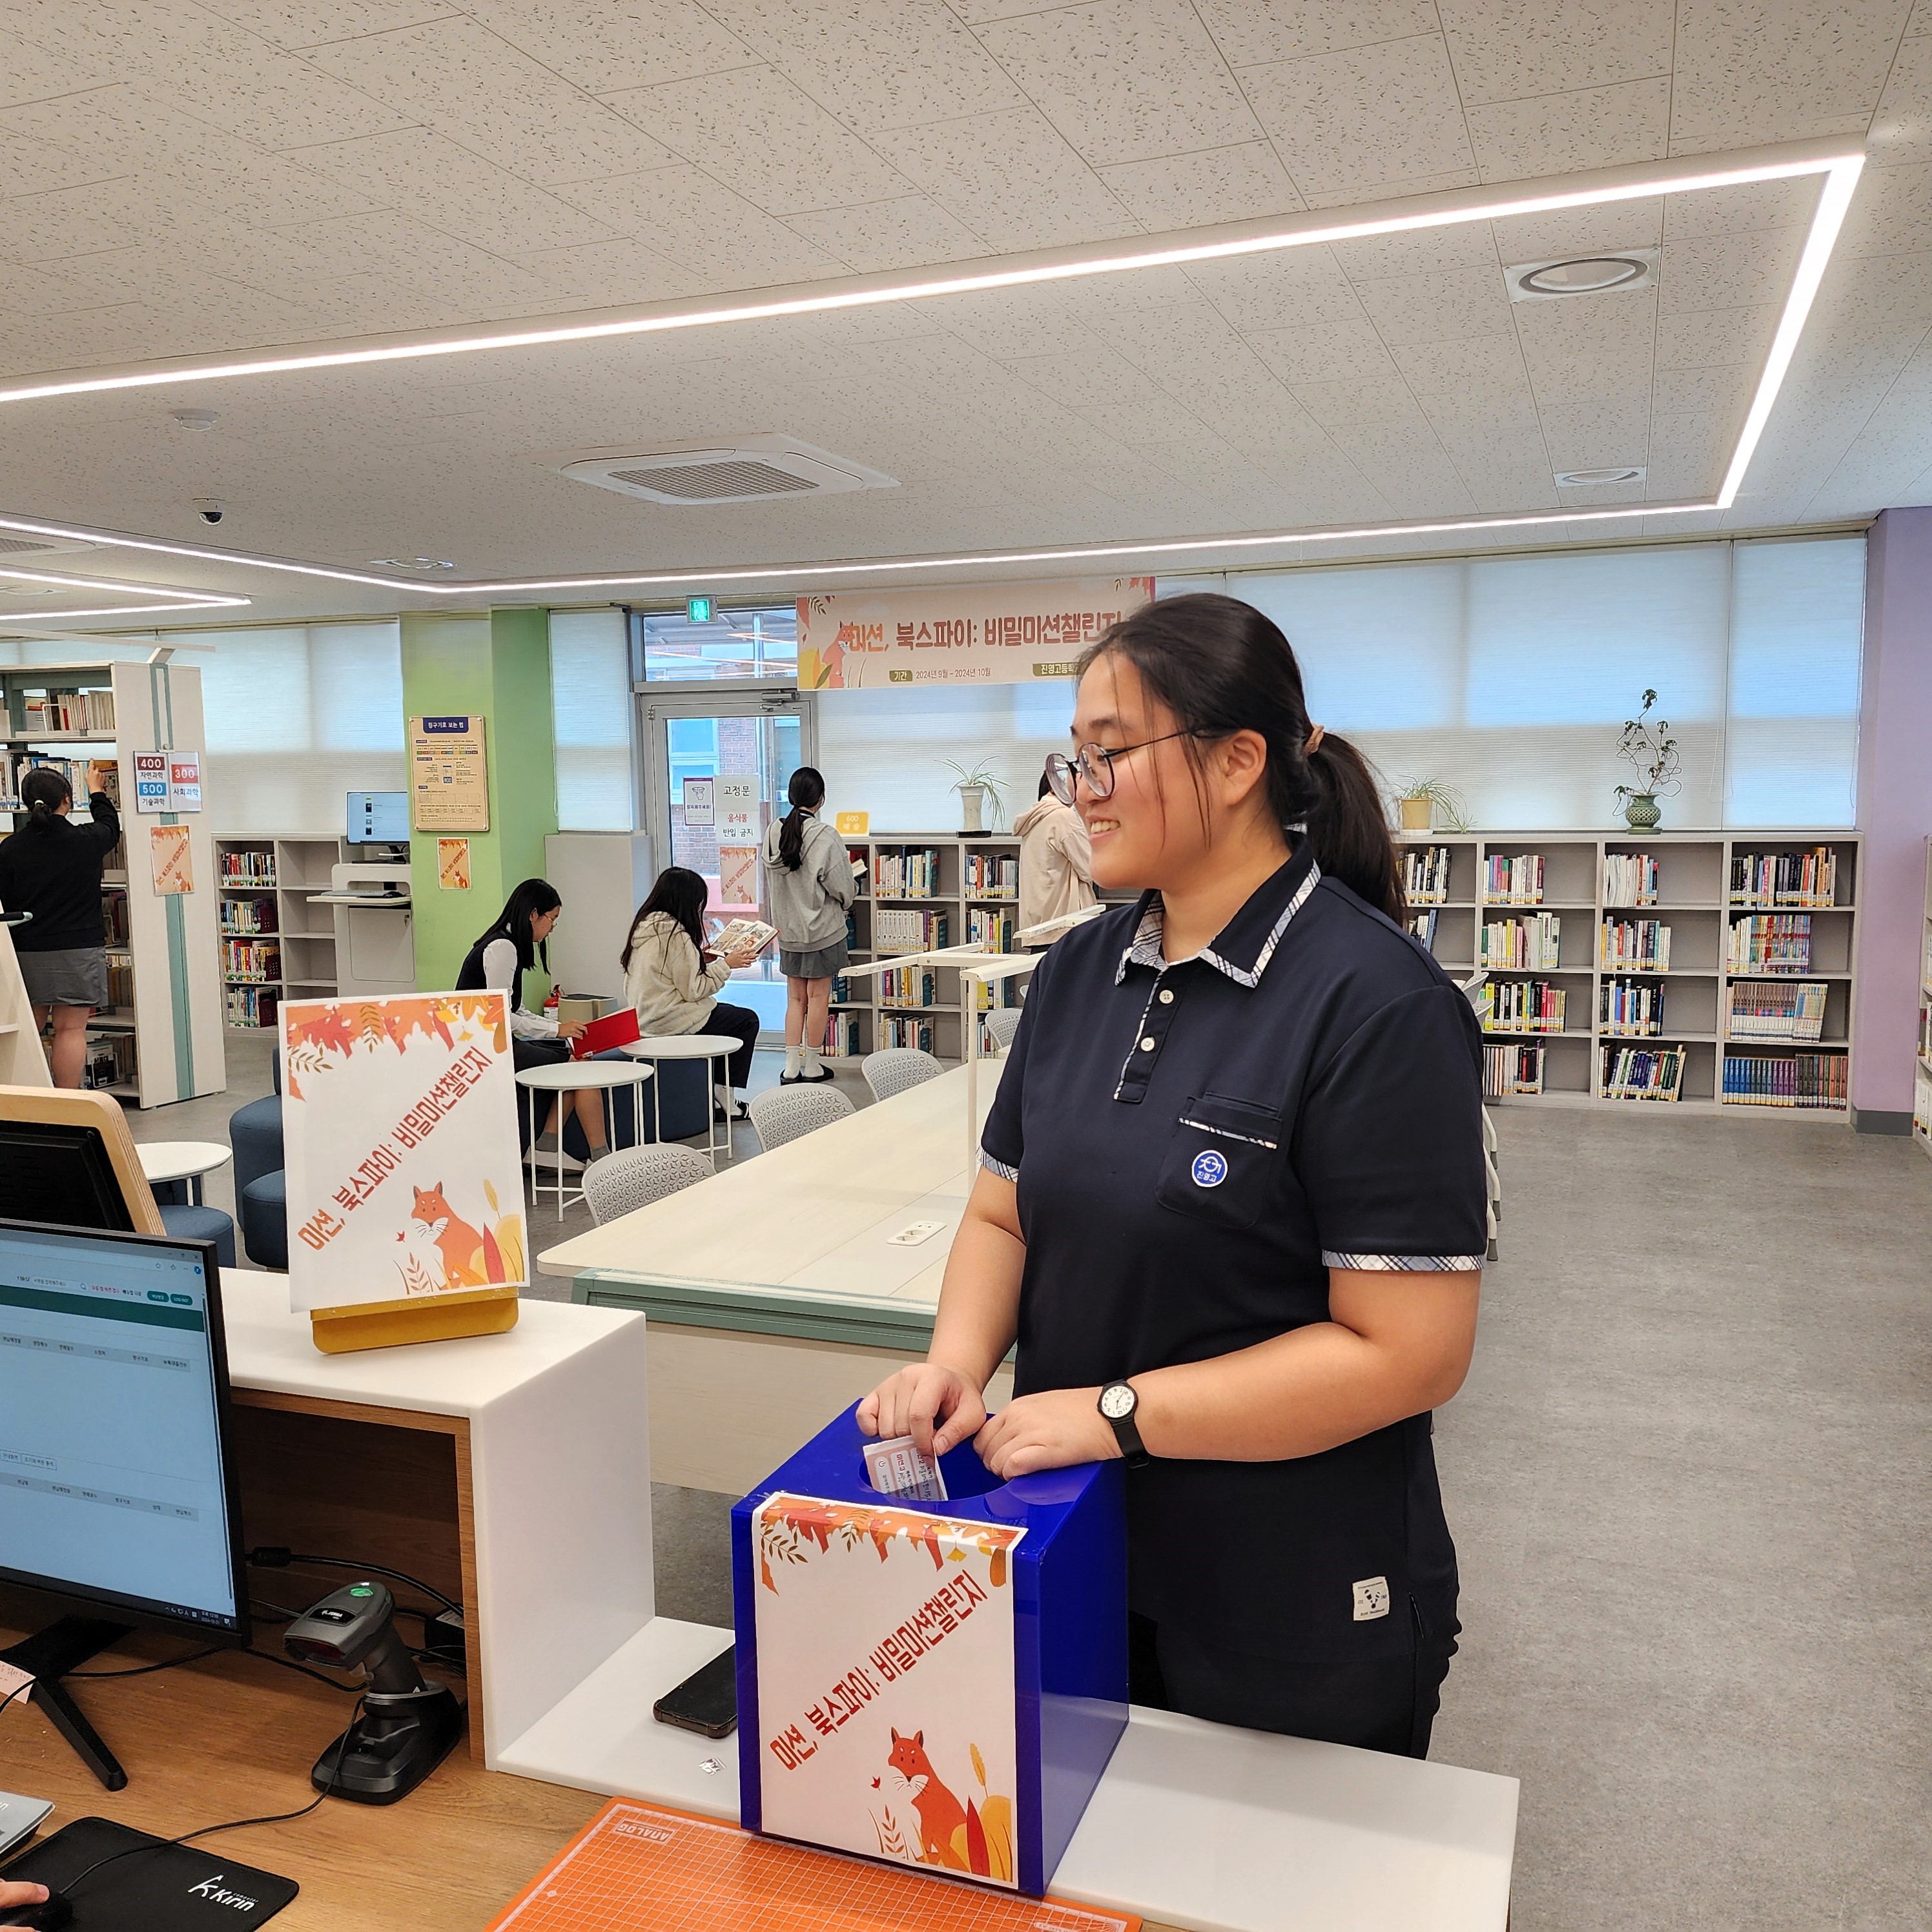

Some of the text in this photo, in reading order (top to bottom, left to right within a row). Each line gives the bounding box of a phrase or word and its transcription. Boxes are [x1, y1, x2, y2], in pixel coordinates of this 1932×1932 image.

[896, 619, 978, 651] 북스파이:
[894, 671, 907, 681] 기간
[916, 670, 937, 679] 2024년
[938, 669, 948, 678] 9월
[954, 668, 976, 677] 2024년
[978, 668, 991, 677] 10월
[1041, 664, 1080, 675] 진영고등학
[141, 758, 161, 768] 400
[140, 772, 163, 780] 자연과학
[174, 768, 194, 779] 300
[143, 784, 163, 794] 500
[173, 788, 199, 797] 사회과학
[723, 785, 751, 797] 고정문
[142, 798, 165, 807] 기술과학
[727, 814, 748, 823] 음식물
[723, 828, 754, 838] 반입 금지
[297, 1045, 494, 1251] 미션, 북스파이: 비밀미션챌린지
[1197, 1170, 1218, 1182] 진영고
[769, 1569, 989, 1771] 미션, 북스파이: 비밀미션챌린지
[617, 1823, 670, 1841] ANALOG
[209, 1889, 255, 1911] Kirin
[232, 1892, 259, 1903] computer
